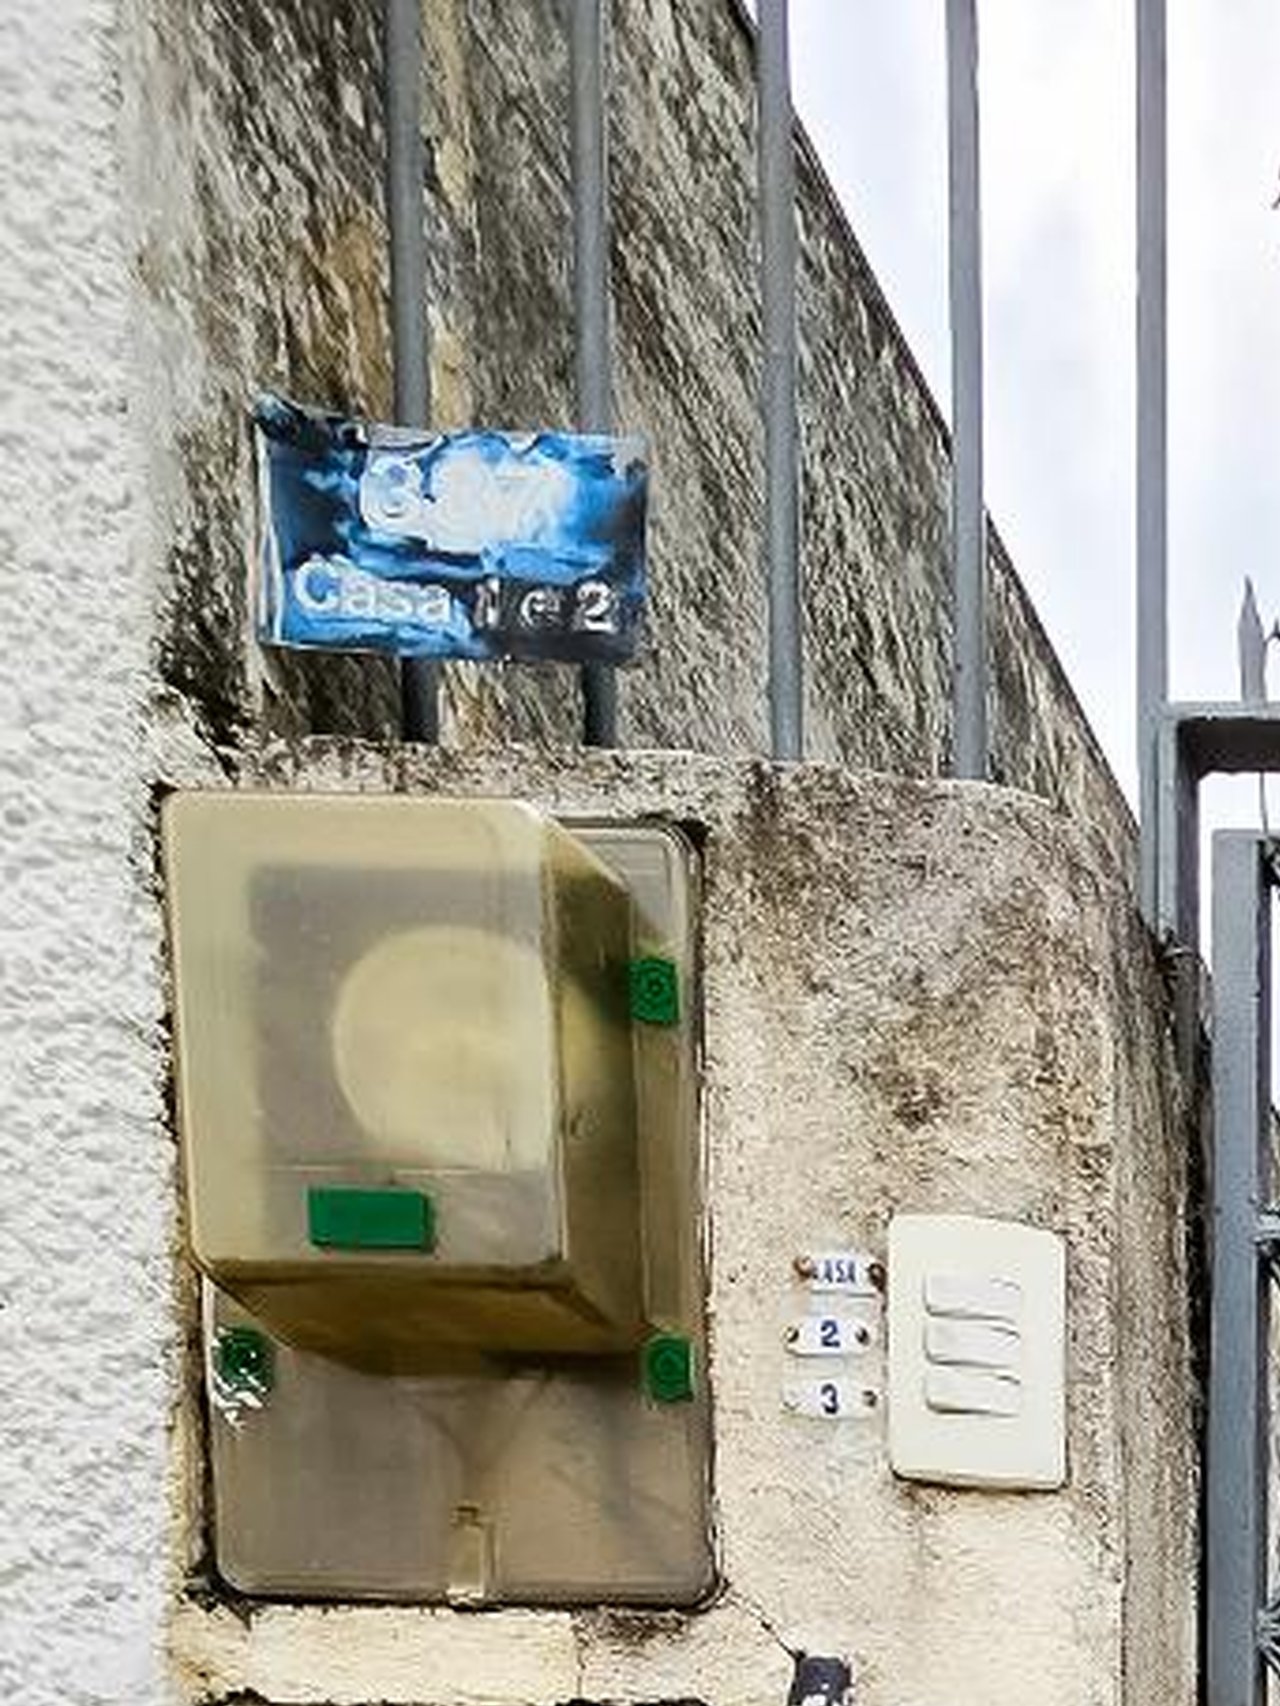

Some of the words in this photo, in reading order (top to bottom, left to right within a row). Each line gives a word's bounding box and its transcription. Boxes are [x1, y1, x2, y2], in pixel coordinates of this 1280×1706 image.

[293, 555, 456, 619] Casa
[578, 581, 615, 632] 2
[808, 1258, 858, 1284] ASA
[820, 1320, 841, 1348] 2
[820, 1383, 840, 1415] 3
